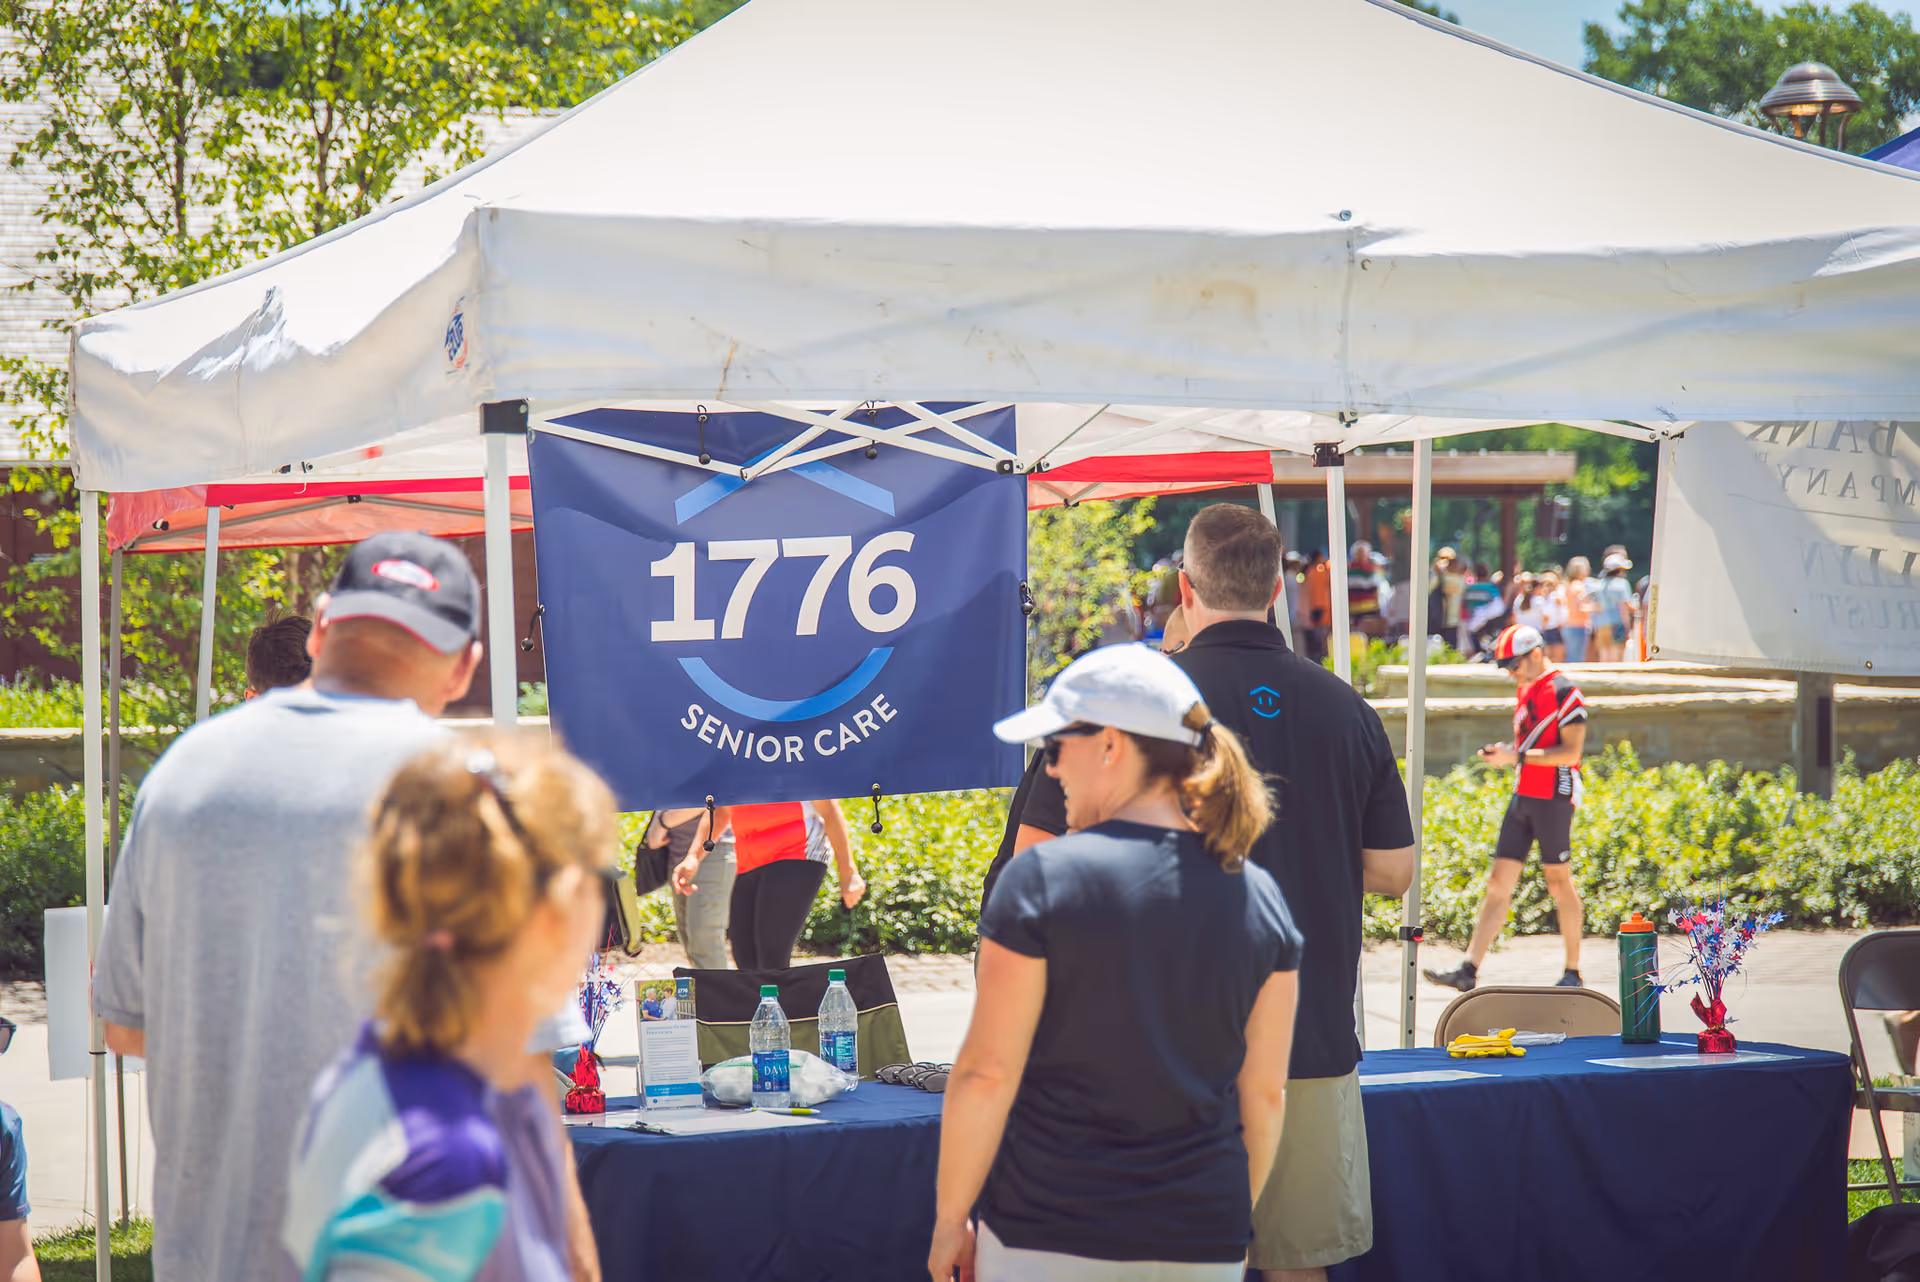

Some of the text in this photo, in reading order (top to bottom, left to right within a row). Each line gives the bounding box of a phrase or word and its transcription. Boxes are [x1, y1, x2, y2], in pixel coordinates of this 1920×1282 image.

[650, 530, 917, 642] 1776
[680, 693, 898, 763] SENIOR CARE
[764, 1063, 789, 1076] DASA
